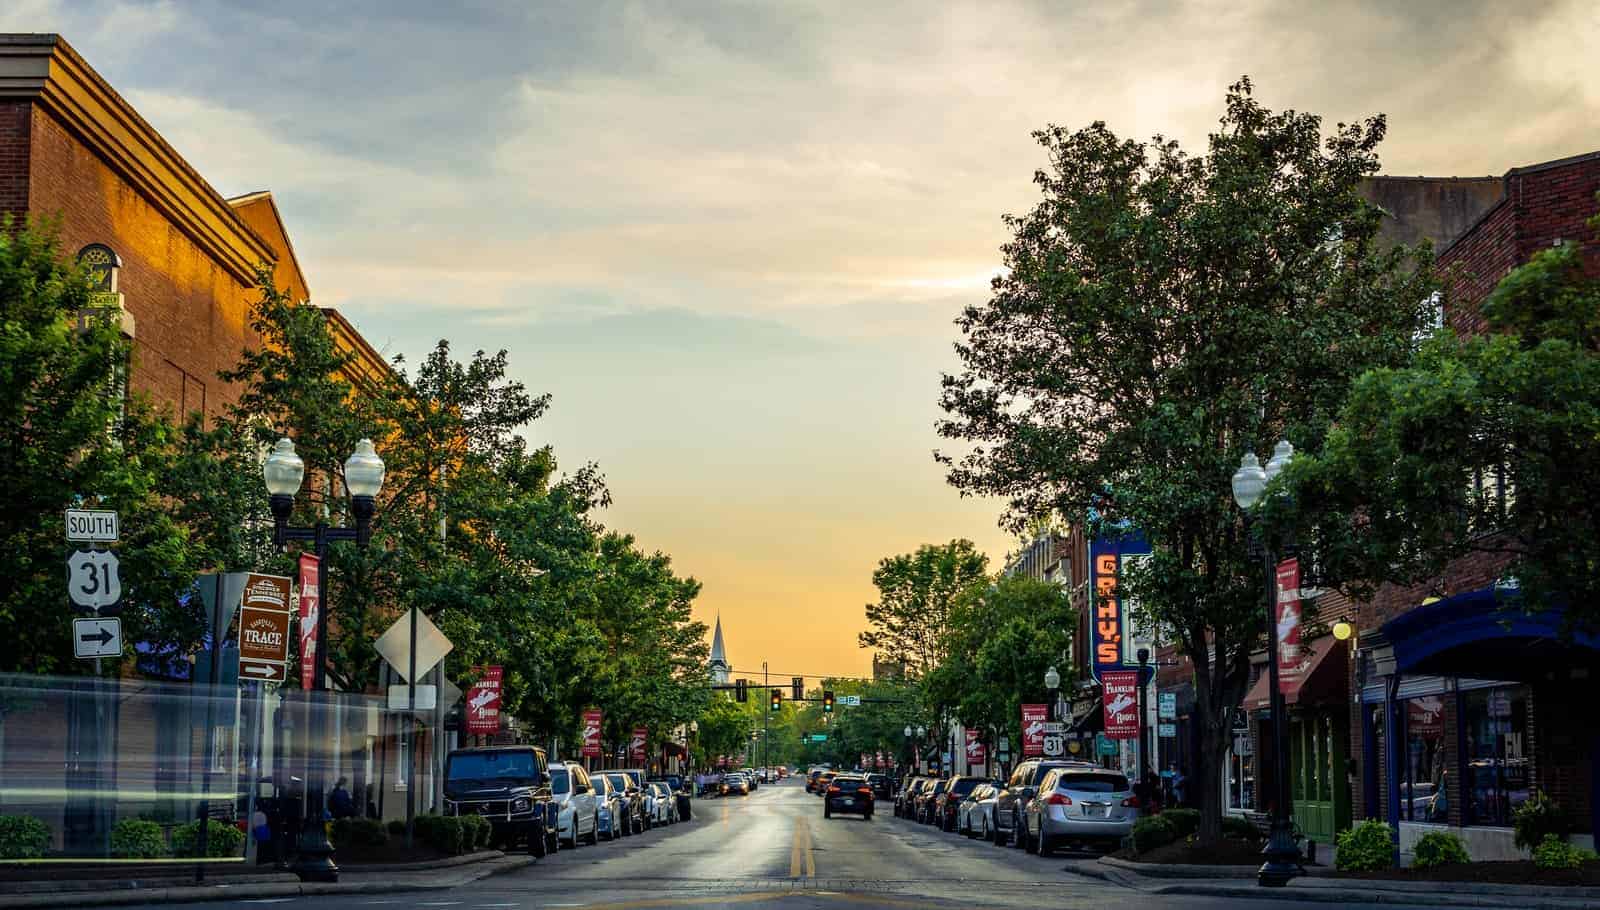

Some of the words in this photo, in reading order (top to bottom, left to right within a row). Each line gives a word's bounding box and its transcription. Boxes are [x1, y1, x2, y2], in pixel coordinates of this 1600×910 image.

[70, 517, 113, 534] SOUTH
[80, 563, 111, 595] 31
[244, 630, 282, 646] TRACE
[1106, 682, 1135, 695] FRANKLIN
[1046, 740, 1060, 752] 31
